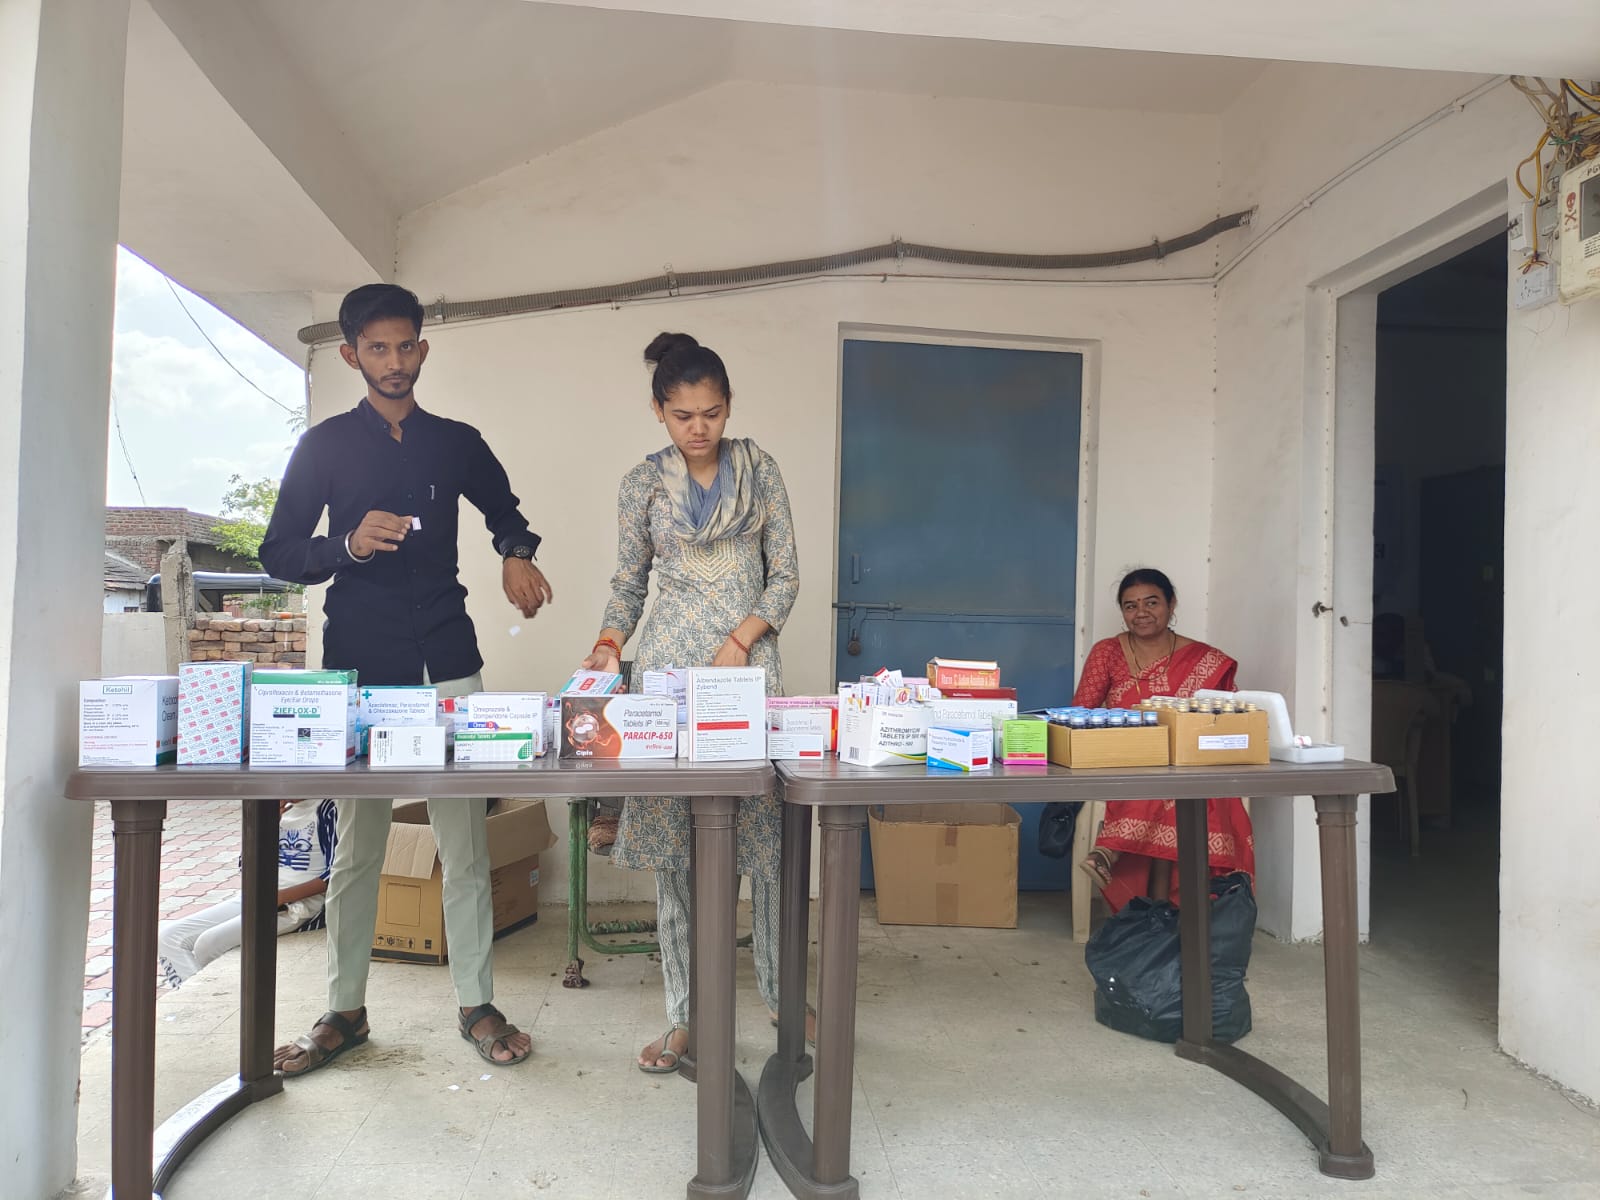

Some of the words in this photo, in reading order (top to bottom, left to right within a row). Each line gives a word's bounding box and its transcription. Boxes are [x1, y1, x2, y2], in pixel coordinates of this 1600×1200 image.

[623, 709, 662, 717] Paracetamol
[623, 719, 645, 728] Tablets
[646, 719, 653, 728] IP
[623, 731, 673, 741] PARACIP-650
